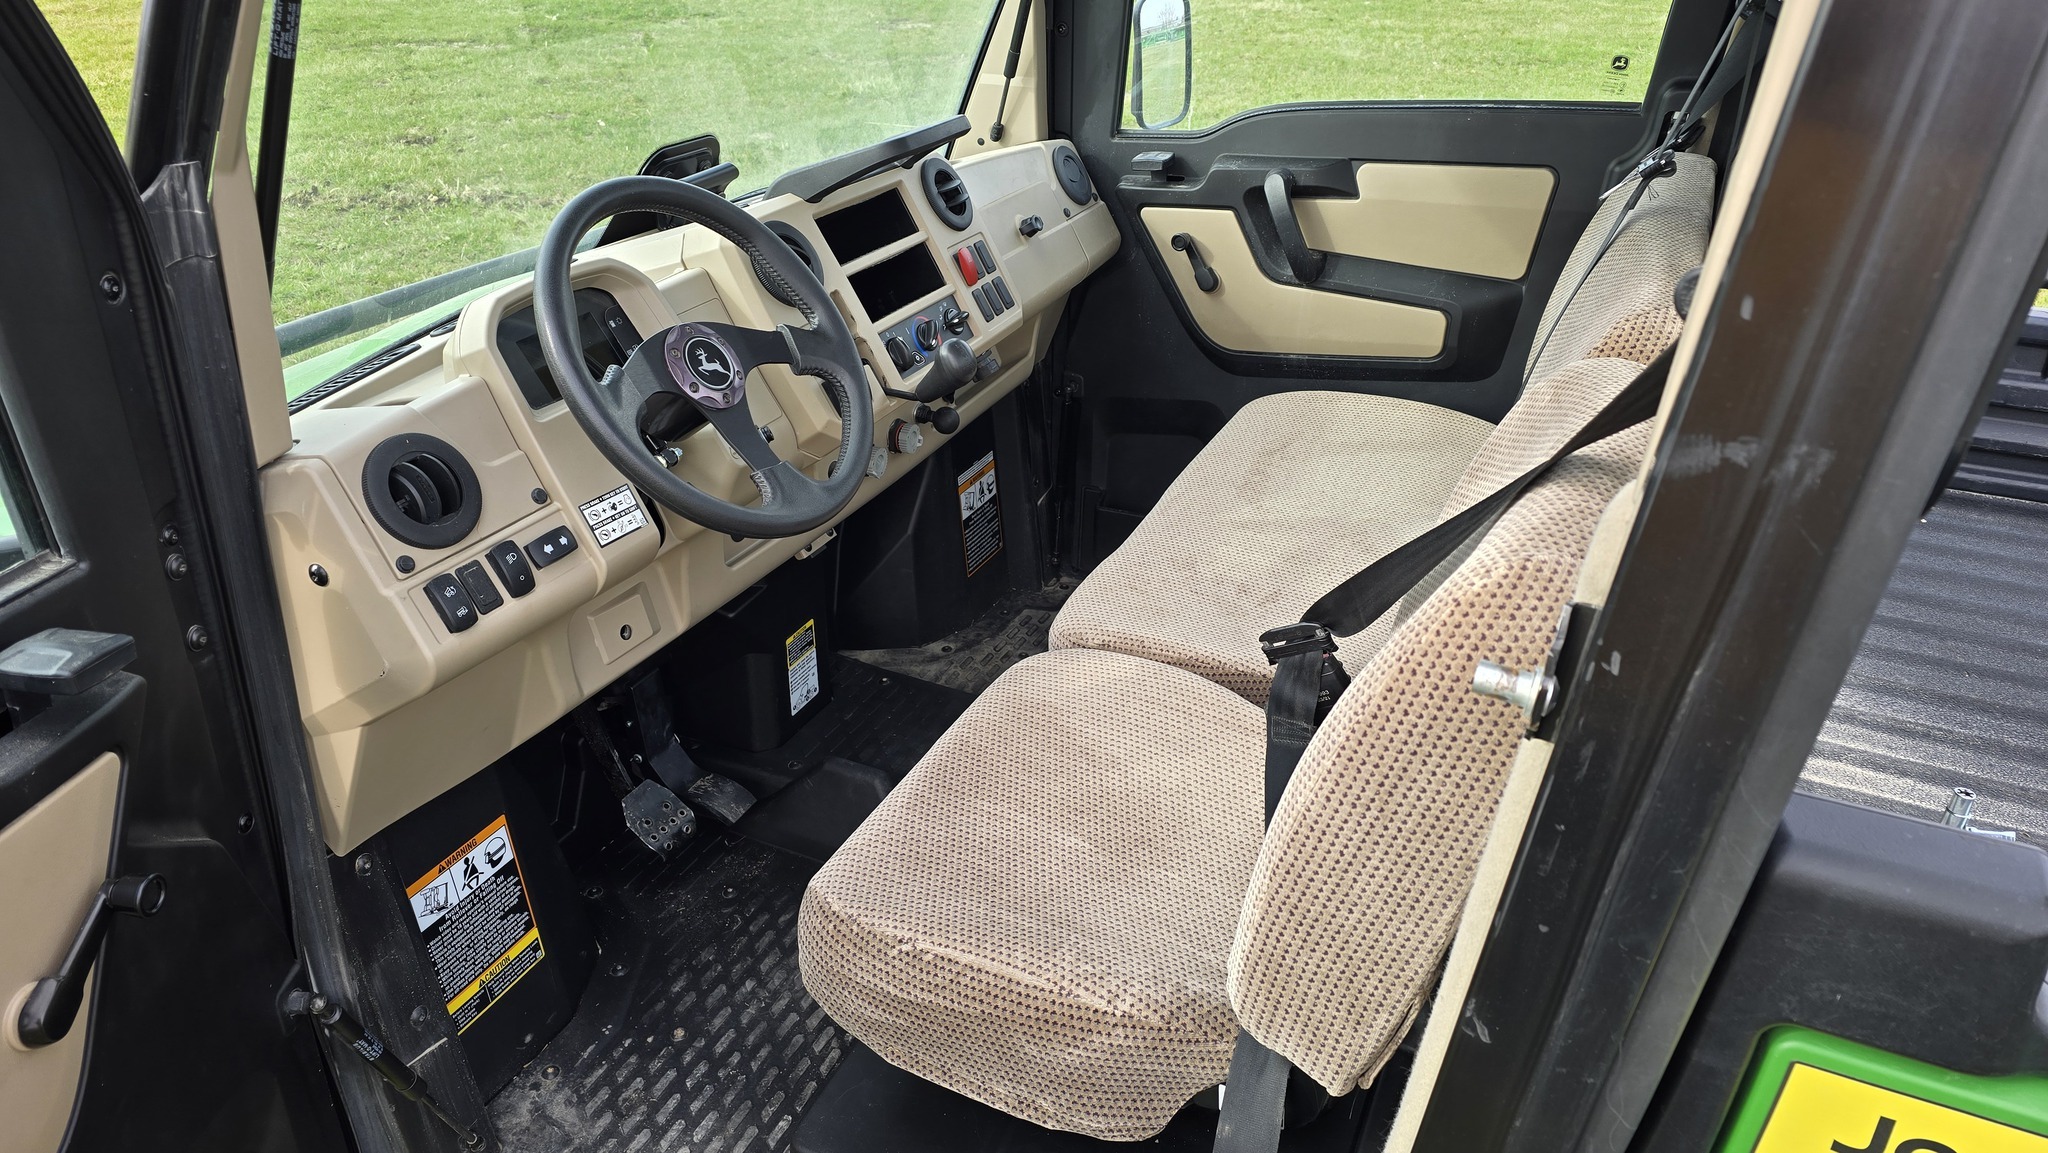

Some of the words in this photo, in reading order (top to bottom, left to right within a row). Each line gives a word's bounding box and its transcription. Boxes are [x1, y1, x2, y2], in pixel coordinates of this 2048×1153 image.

[445, 838, 477, 868] WARNING
[439, 918, 451, 933] from
[452, 900, 473, 922] Rollover
[473, 895, 480, 904] or
[479, 881, 496, 899] Falling
[445, 905, 459, 921] Avoid
[460, 892, 475, 908] Injury
[475, 887, 481, 896] or
[481, 875, 495, 891] Death
[484, 954, 511, 982] CAUTION
